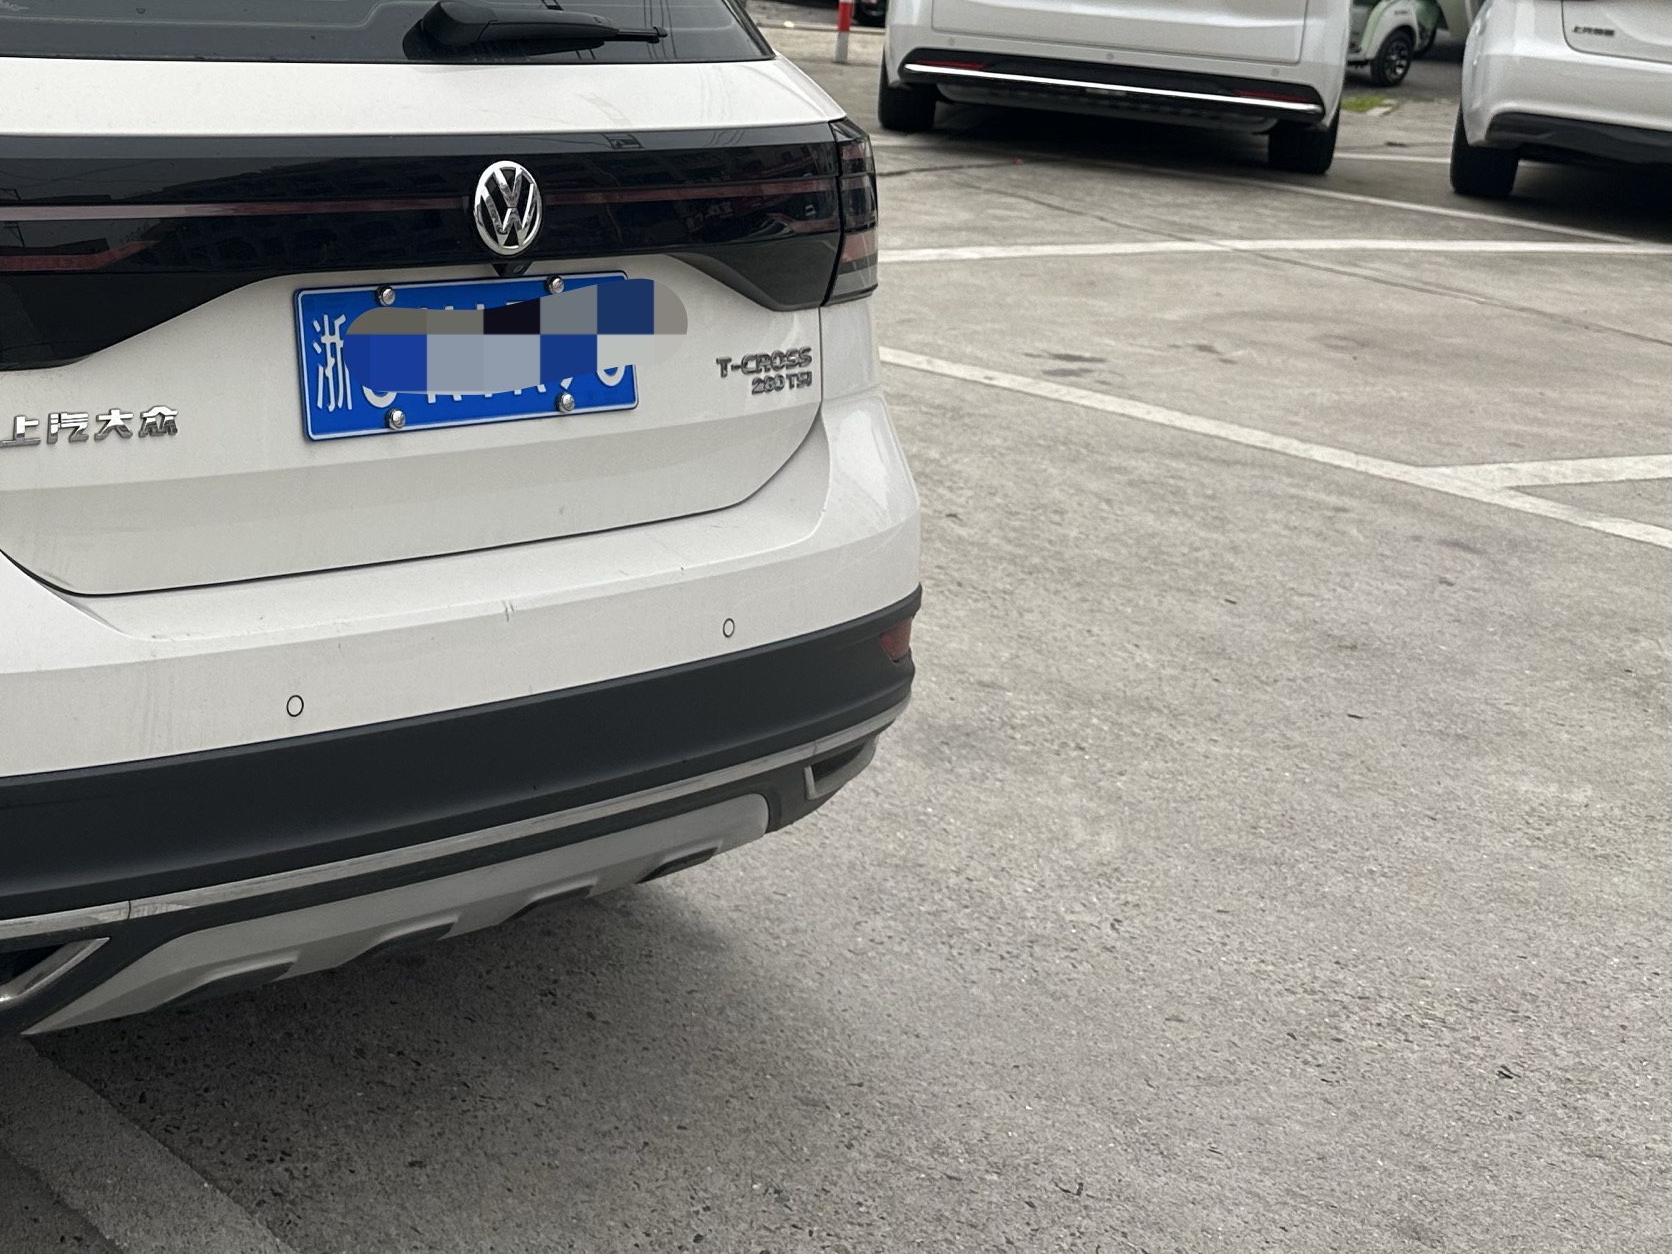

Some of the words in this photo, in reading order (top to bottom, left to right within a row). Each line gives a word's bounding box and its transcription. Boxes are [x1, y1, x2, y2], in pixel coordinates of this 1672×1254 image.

[715, 346, 812, 378] T-CROSS
[0, 405, 177, 448] 上汽大众
